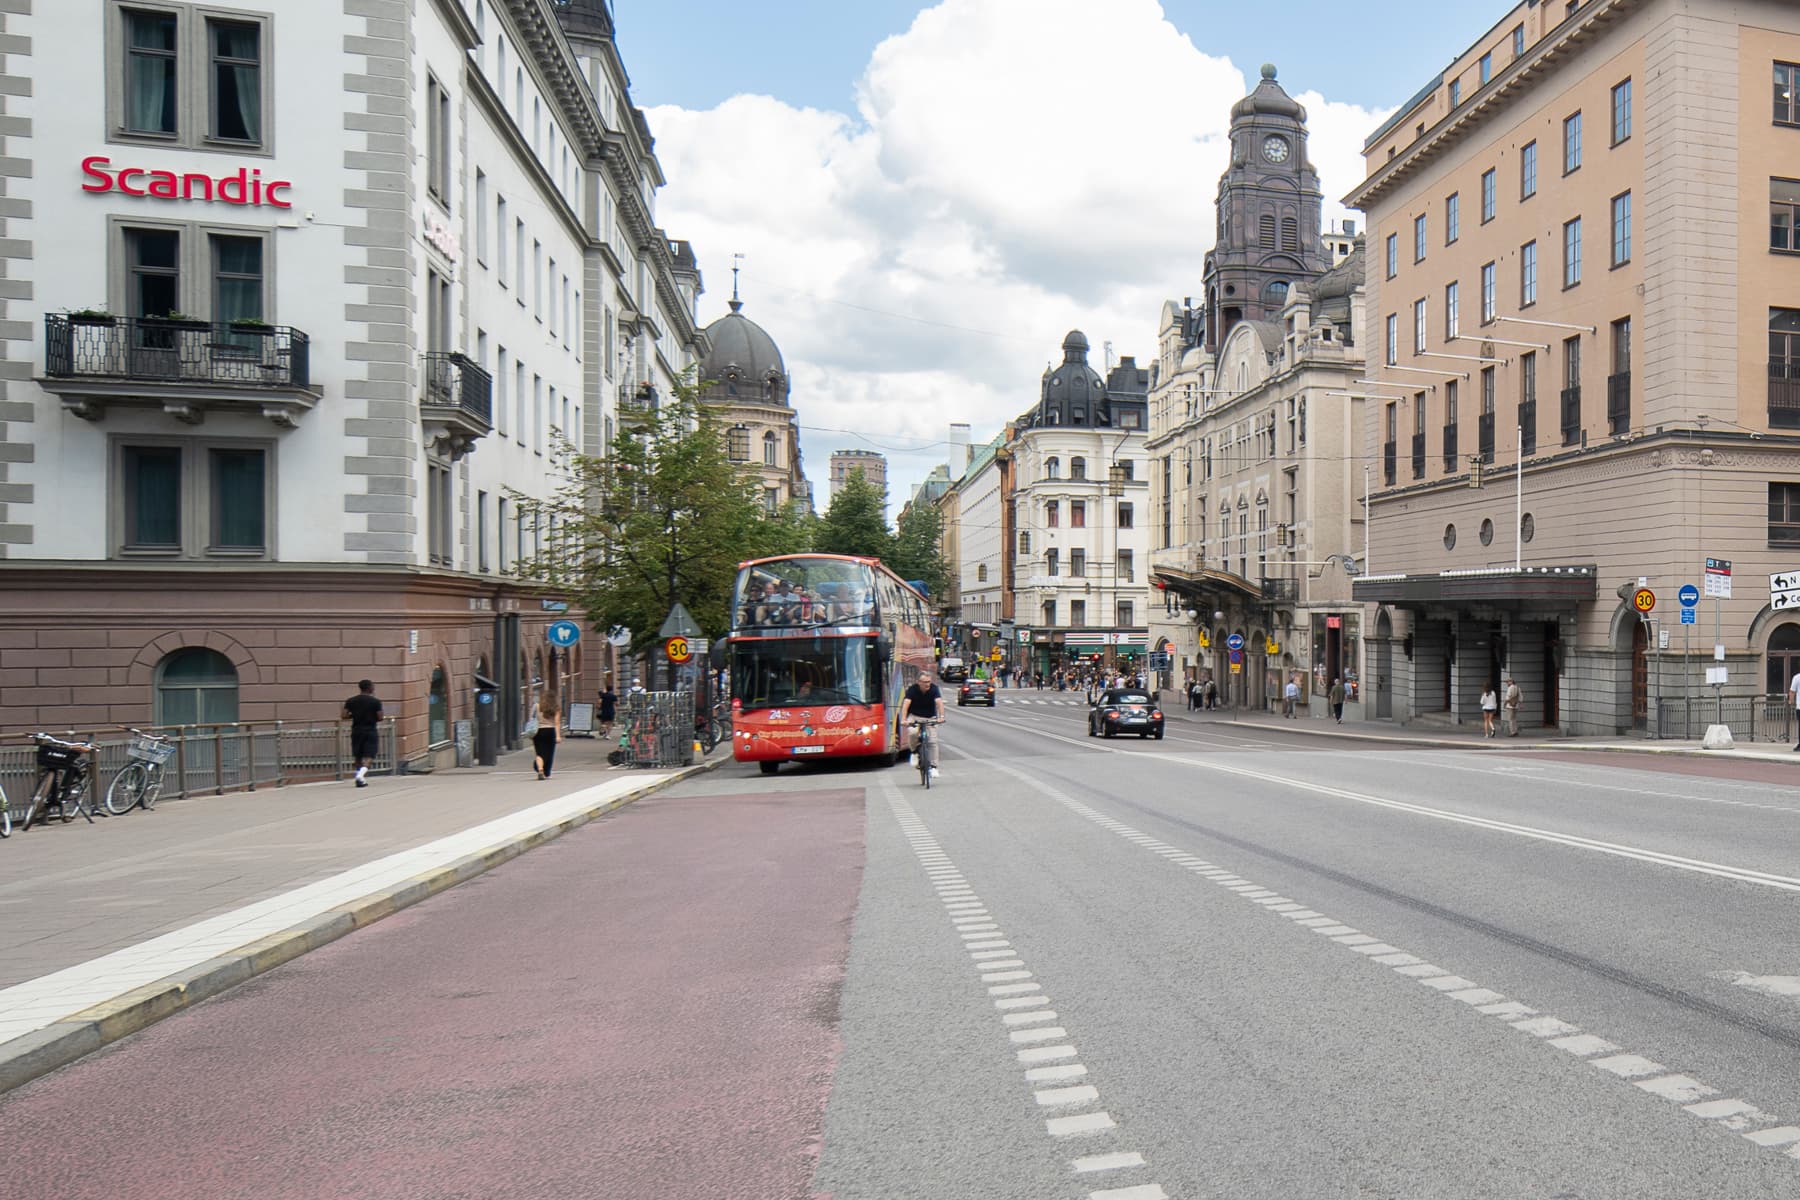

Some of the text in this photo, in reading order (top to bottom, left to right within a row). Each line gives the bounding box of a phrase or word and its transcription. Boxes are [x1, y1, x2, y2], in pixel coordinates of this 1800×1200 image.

[81, 156, 293, 208] Scandic
[1790, 576, 1797, 585] N
[1638, 595, 1652, 606] 30
[670, 643, 688, 657] 30
